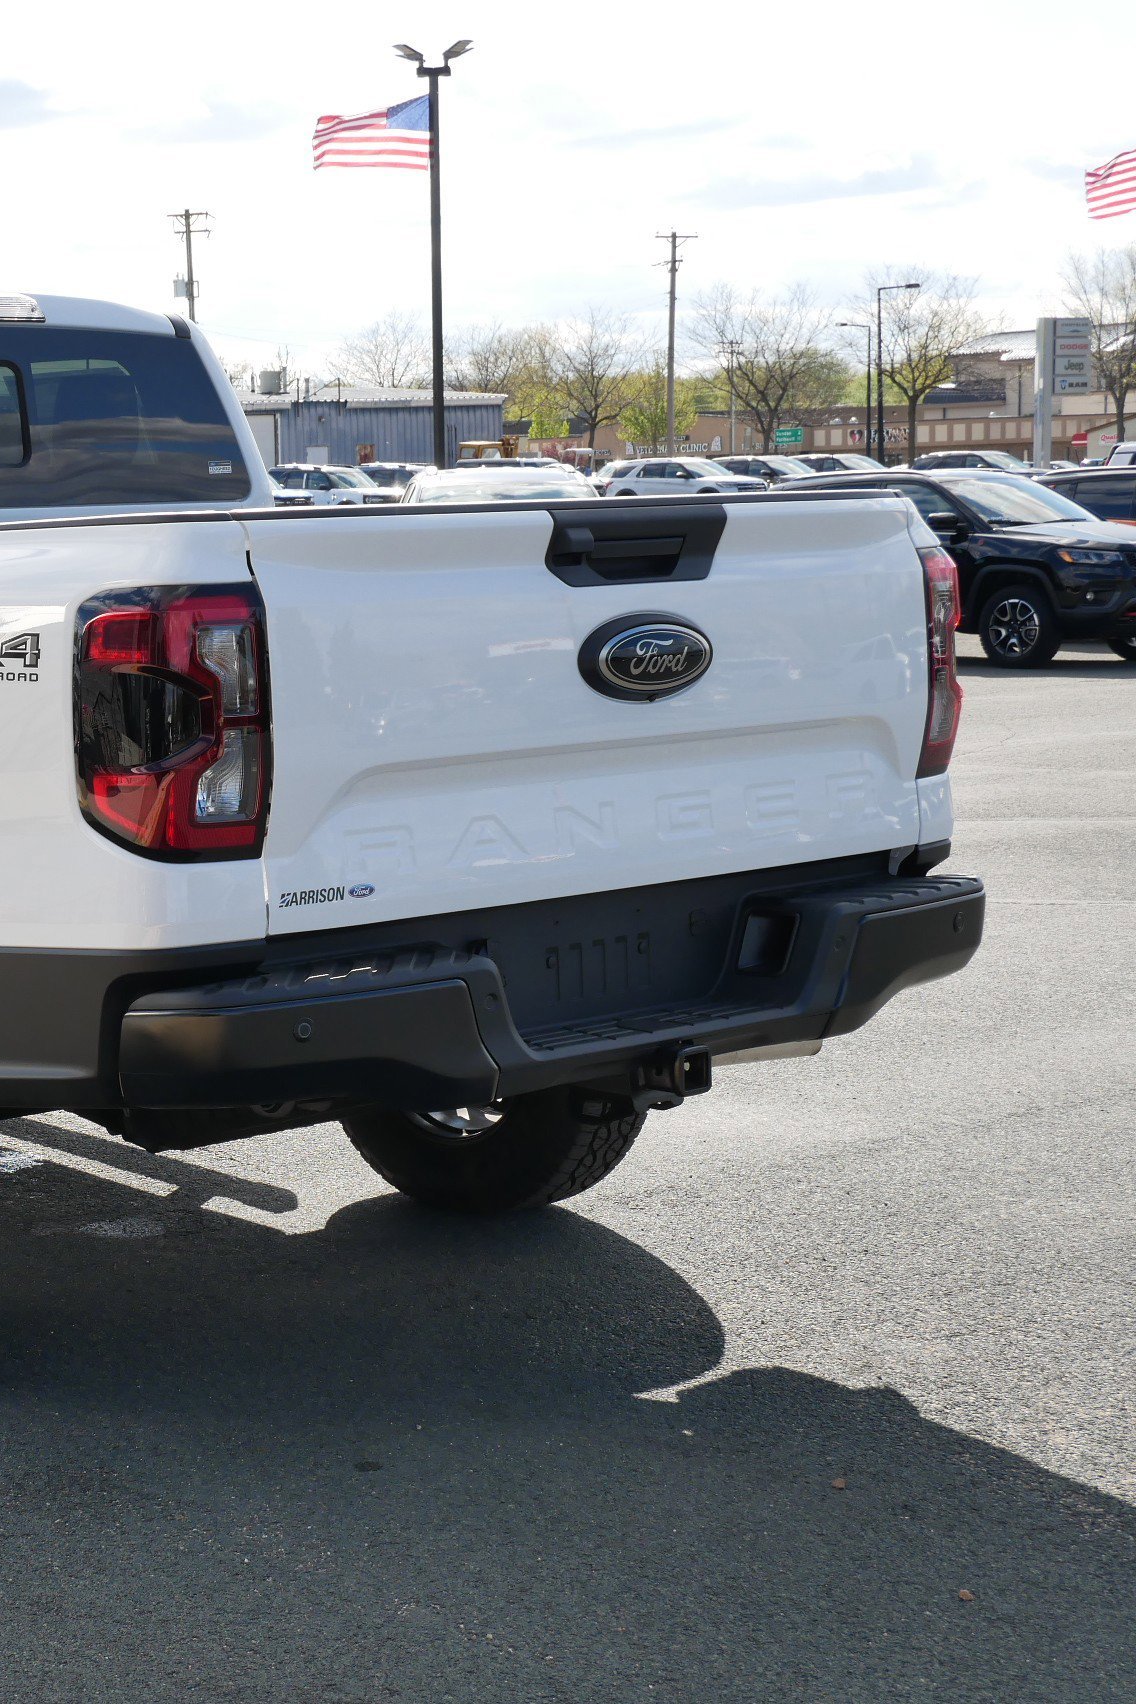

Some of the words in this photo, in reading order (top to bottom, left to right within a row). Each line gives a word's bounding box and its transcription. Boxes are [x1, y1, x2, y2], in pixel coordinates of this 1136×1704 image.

[1064, 359, 1084, 372] Jeep
[680, 442, 708, 453] CLINIC
[630, 638, 688, 675] Ford
[339, 768, 888, 880] RANGER
